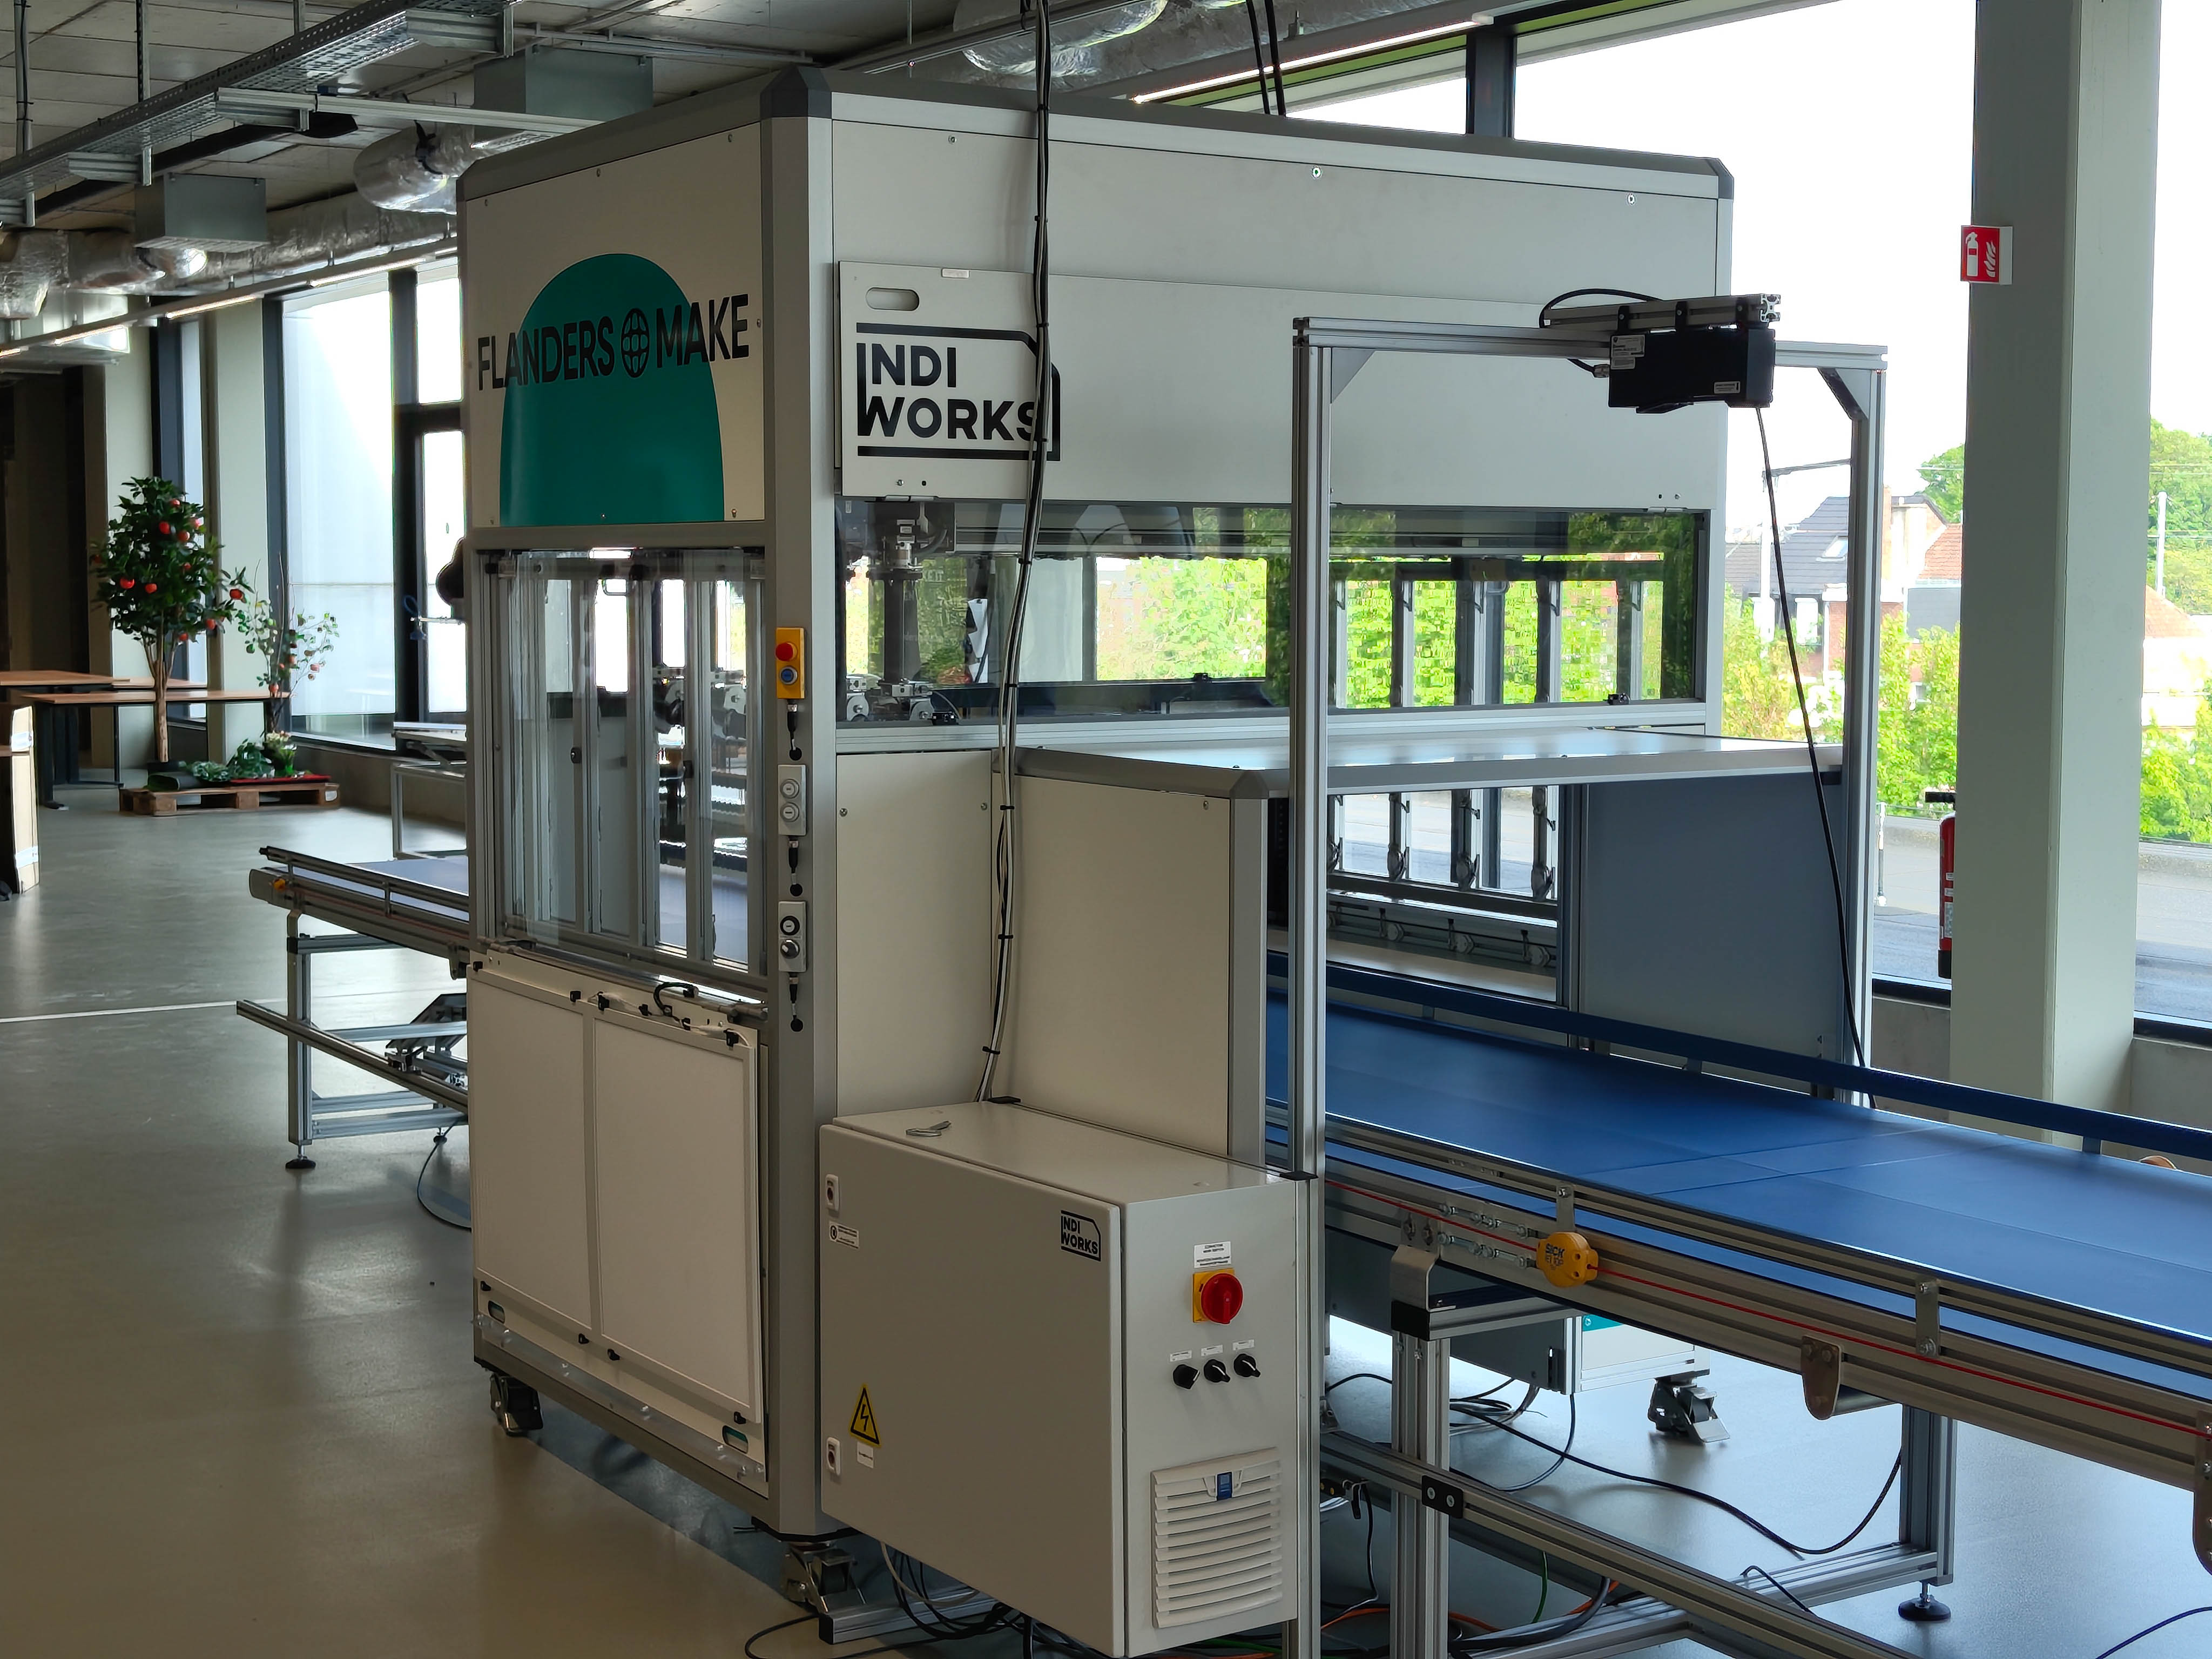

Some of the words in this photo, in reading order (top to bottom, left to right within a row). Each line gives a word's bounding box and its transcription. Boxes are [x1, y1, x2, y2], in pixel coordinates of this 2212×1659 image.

[478, 316, 615, 391] FLANDERS
[656, 294, 750, 368] MAKE
[857, 343, 956, 388] INDI
[857, 396, 1034, 442] WORKS
[1061, 1216, 1080, 1234] INDI
[1061, 1232, 1098, 1255] WORKS
